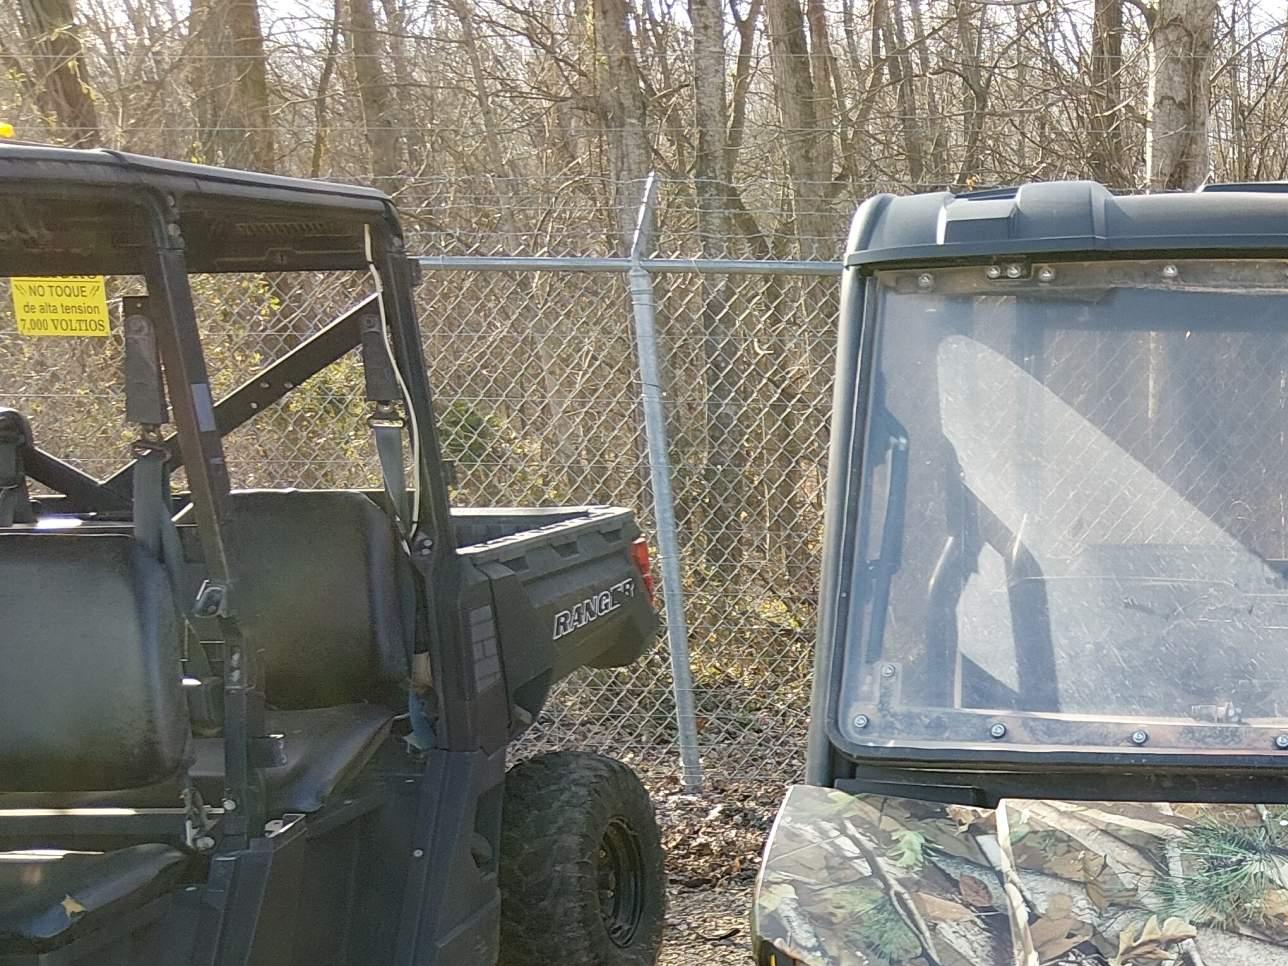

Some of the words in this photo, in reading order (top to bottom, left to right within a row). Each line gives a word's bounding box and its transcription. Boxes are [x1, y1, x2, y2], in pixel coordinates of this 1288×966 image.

[28, 285, 45, 297] NO
[48, 285, 88, 298] TOQUE
[23, 302, 36, 314] de
[40, 302, 58, 314] alta
[61, 302, 101, 315] tension
[50, 319, 106, 332] VOLTIOS
[552, 578, 635, 641] RANGER
